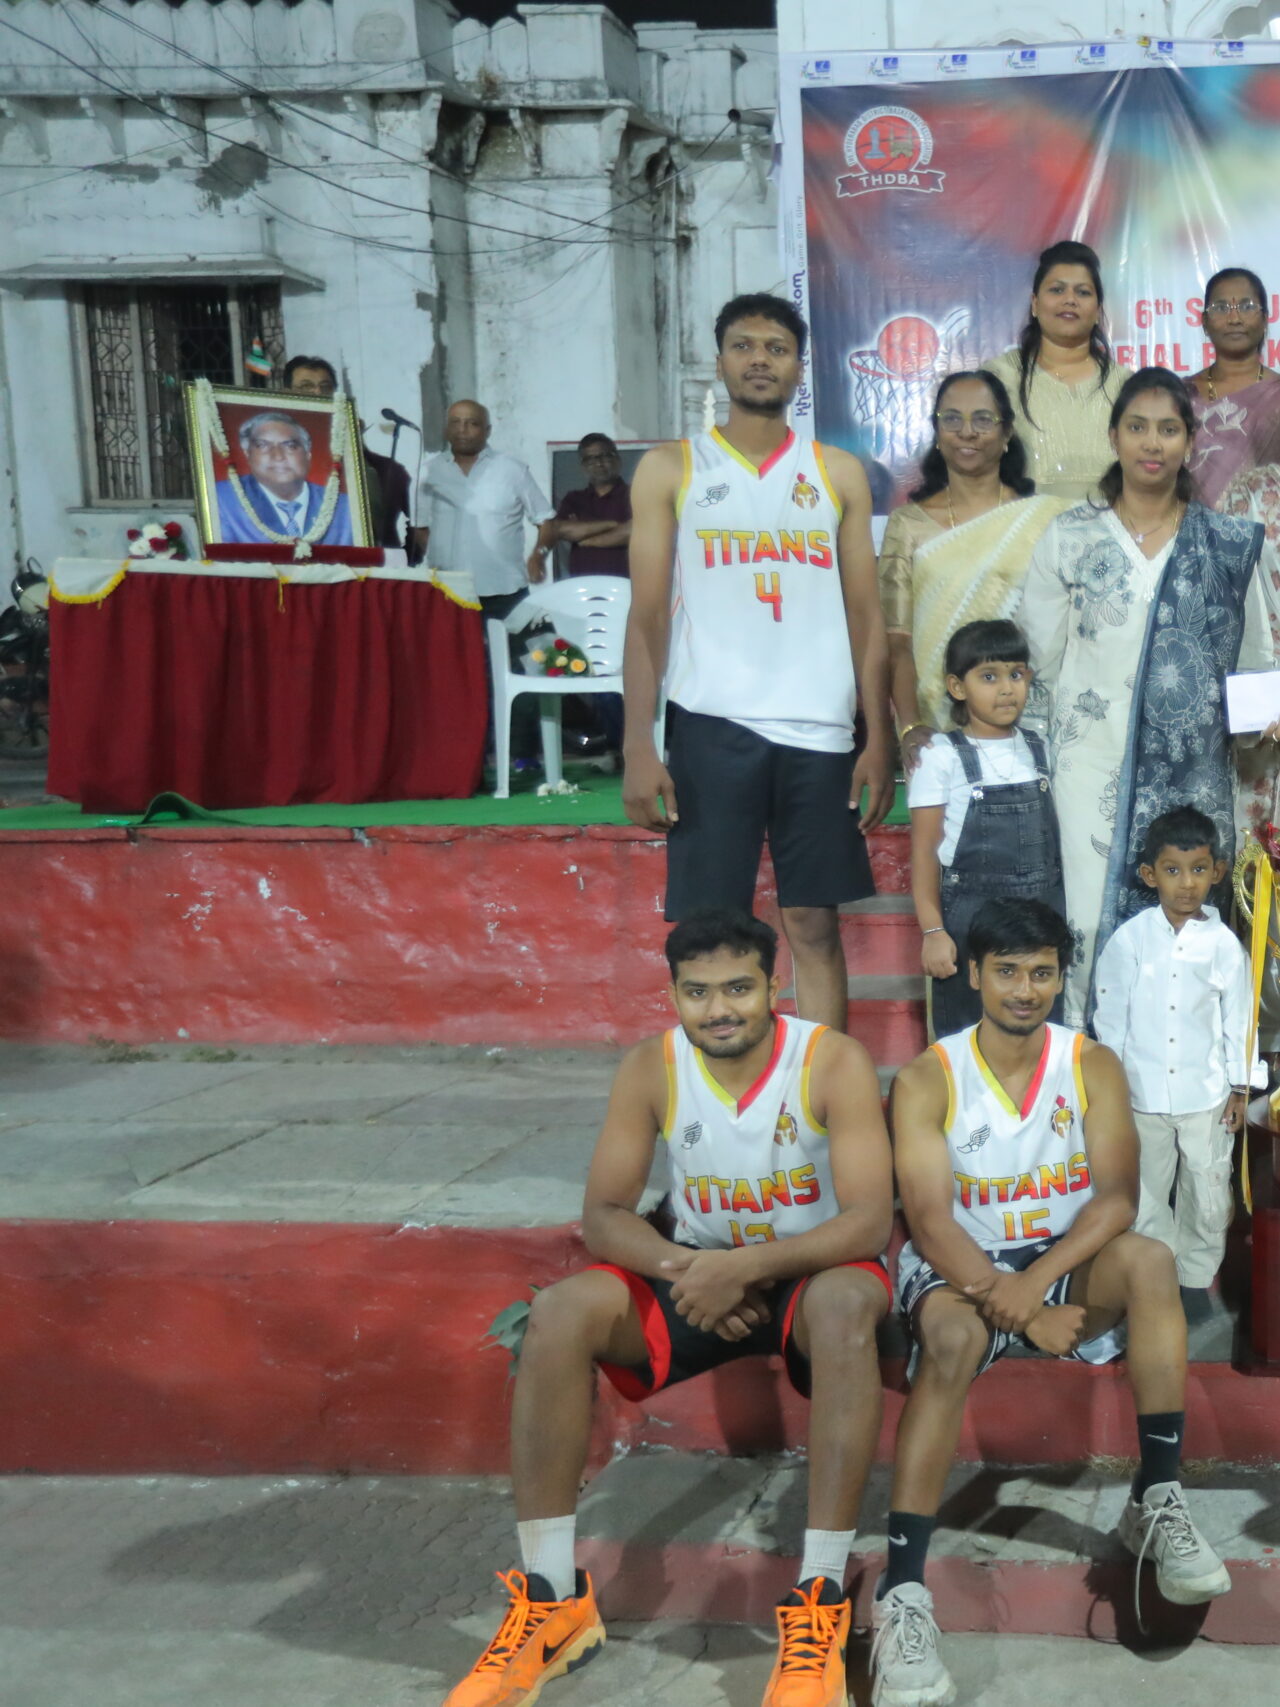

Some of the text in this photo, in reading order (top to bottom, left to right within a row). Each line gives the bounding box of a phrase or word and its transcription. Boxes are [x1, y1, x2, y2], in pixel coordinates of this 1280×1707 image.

[859, 172, 920, 187] THDBA
[1135, 297, 1174, 329] 6th
[696, 529, 833, 569] TITANS
[753, 572, 783, 622] 4
[684, 1163, 821, 1213] TITANS
[954, 1152, 1091, 1209] TITANS
